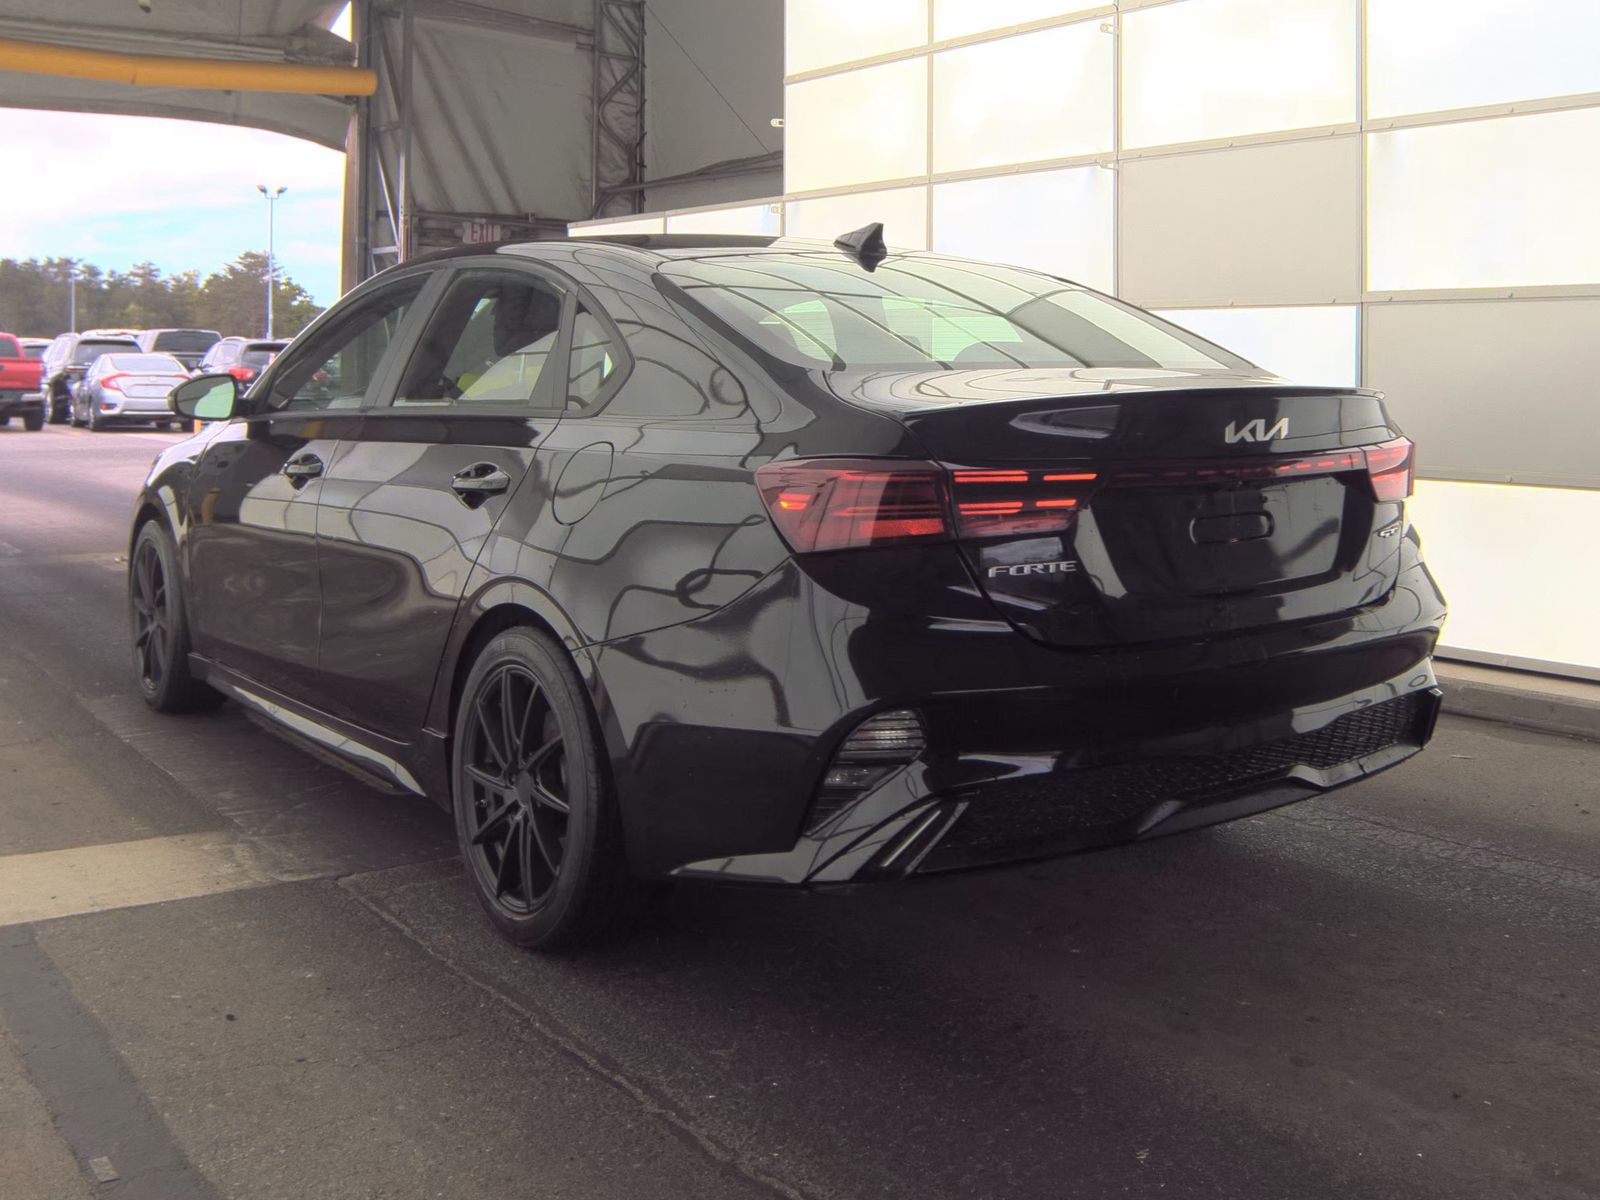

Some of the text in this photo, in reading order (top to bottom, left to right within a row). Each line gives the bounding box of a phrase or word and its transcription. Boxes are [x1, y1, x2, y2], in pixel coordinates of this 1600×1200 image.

[470, 223, 497, 243] EXIT
[1224, 417, 1289, 443] KIA
[988, 560, 1077, 578] FORTE
